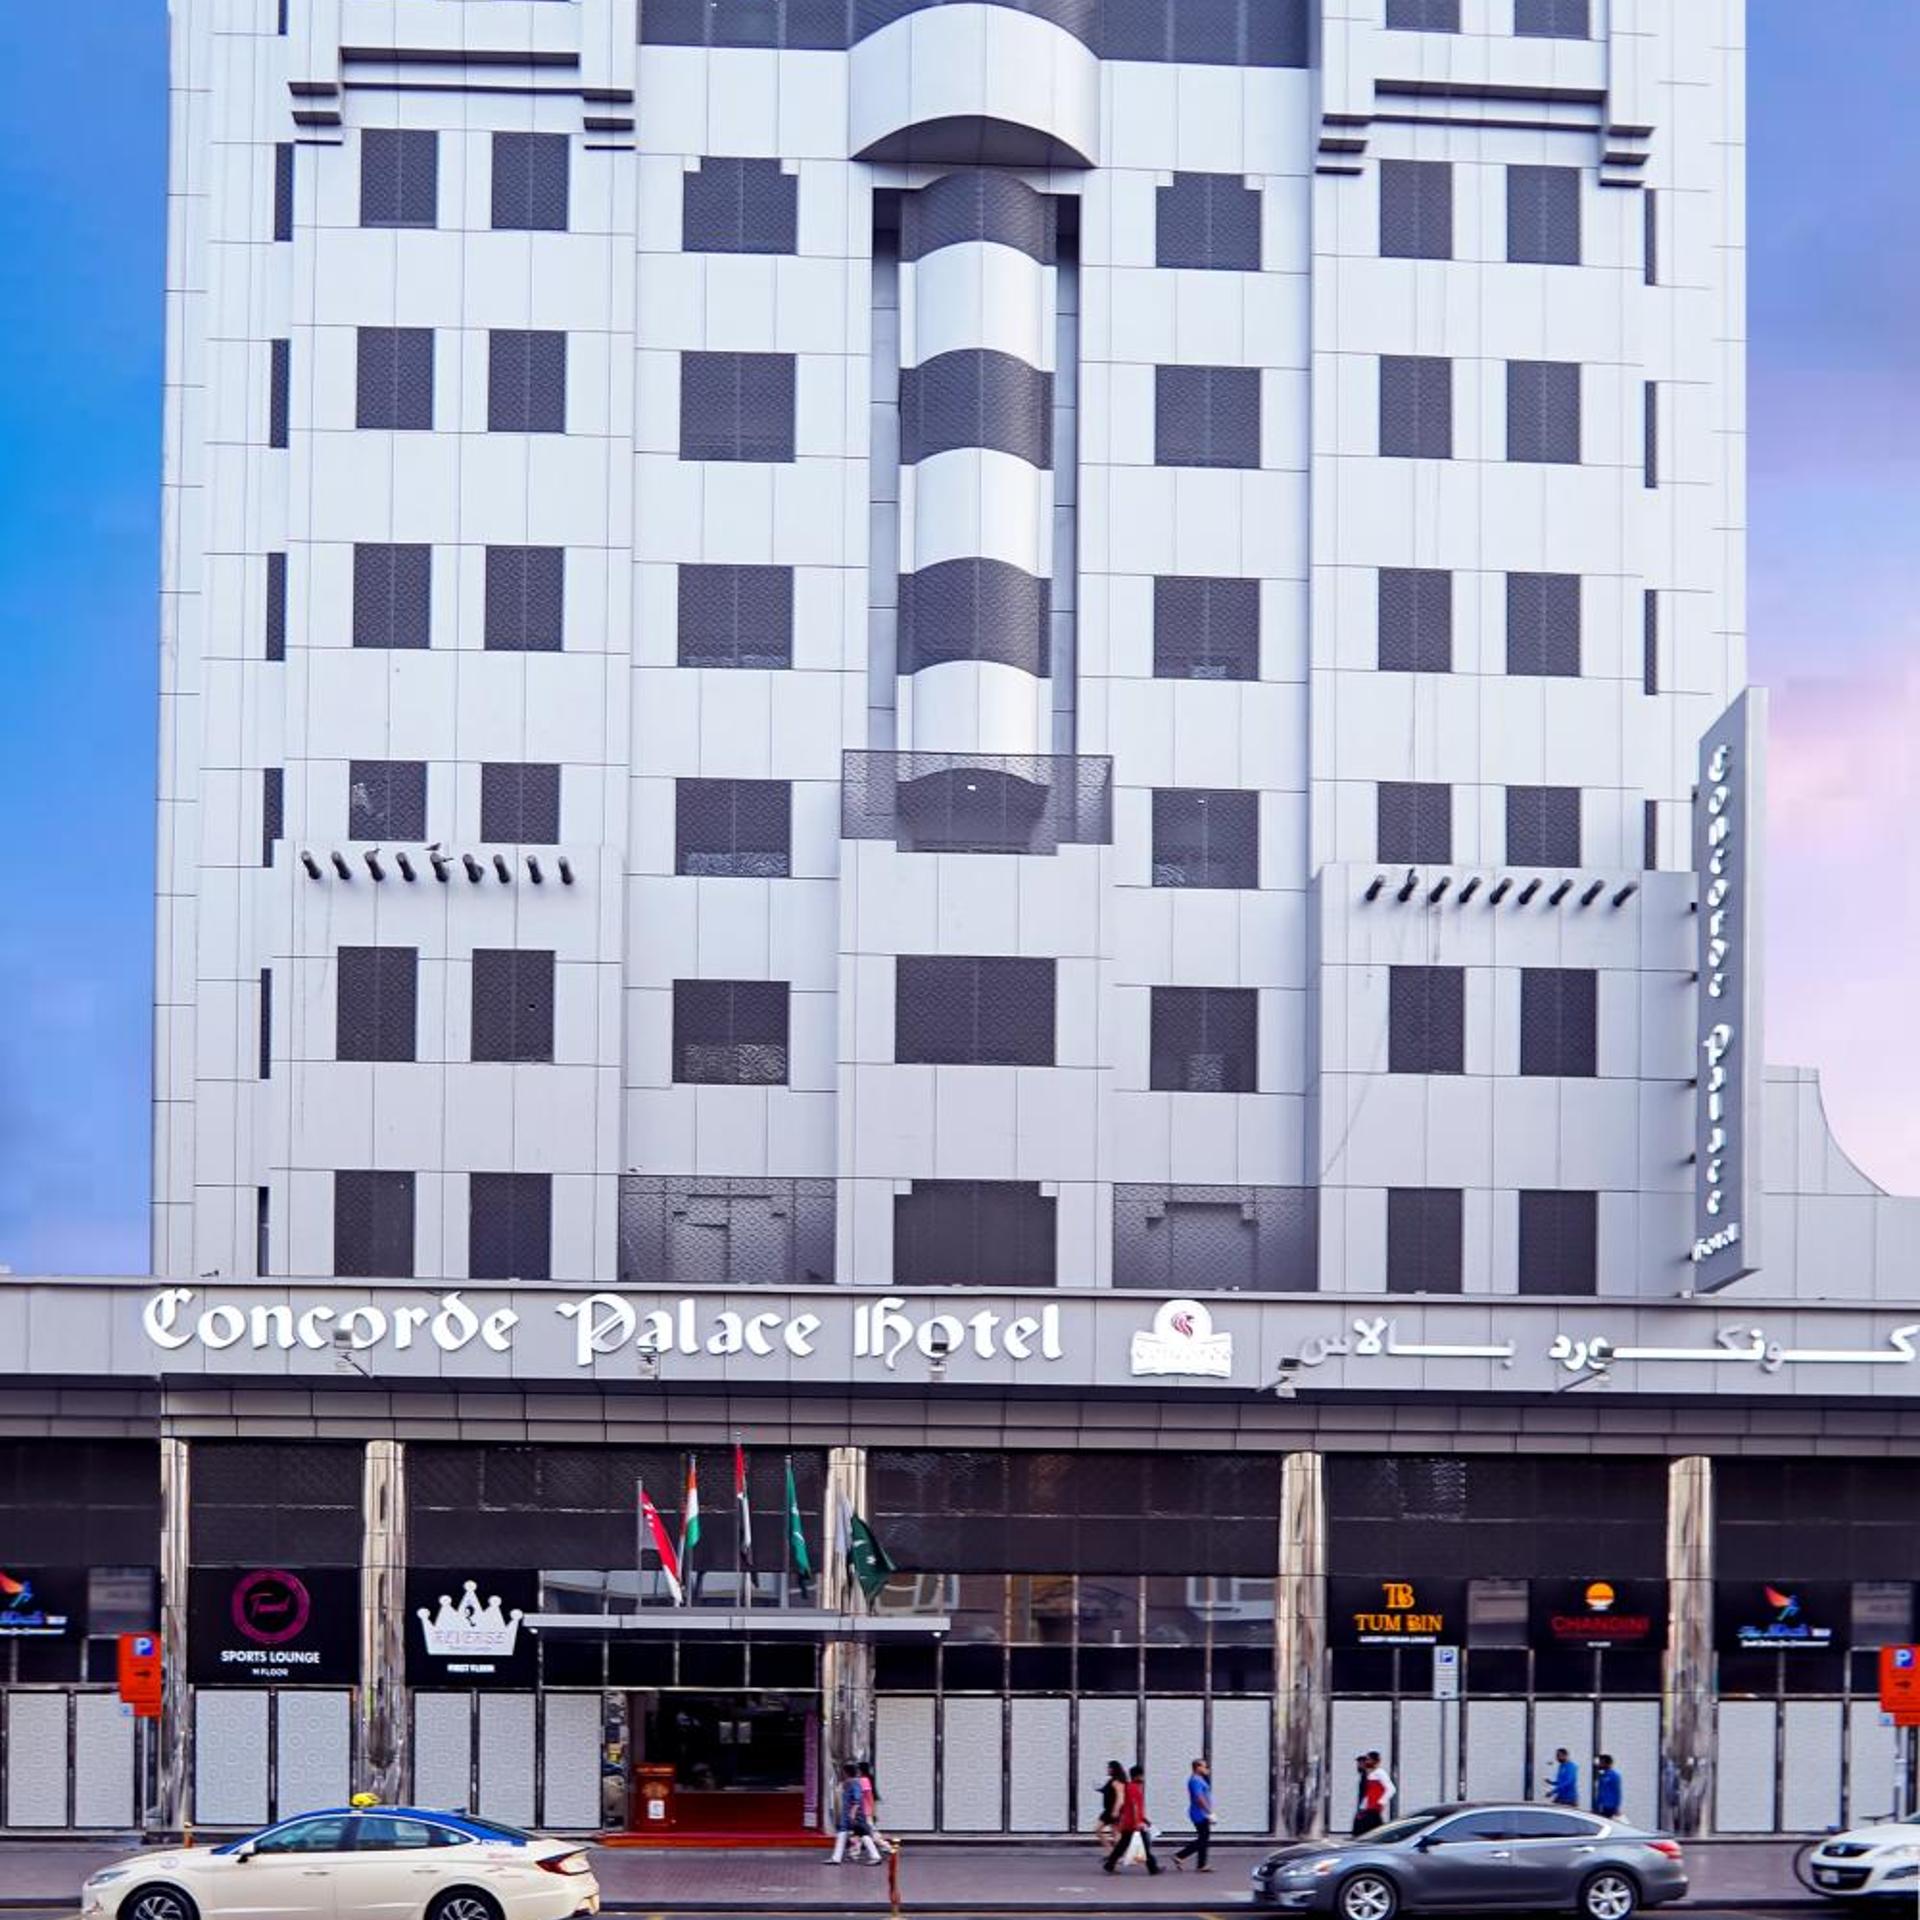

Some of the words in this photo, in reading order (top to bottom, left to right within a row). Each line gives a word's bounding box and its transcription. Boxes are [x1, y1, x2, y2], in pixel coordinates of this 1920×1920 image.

[143, 1288, 519, 1351] Concorde
[555, 1293, 821, 1367] Palace
[854, 1297, 1063, 1370] Hotel
[1382, 1583, 1415, 1609] TB
[1354, 1614, 1401, 1631] TUM
[1406, 1614, 1443, 1632] BIN
[220, 1650, 267, 1662] SPORTS
[269, 1651, 320, 1664] LOUNGE
